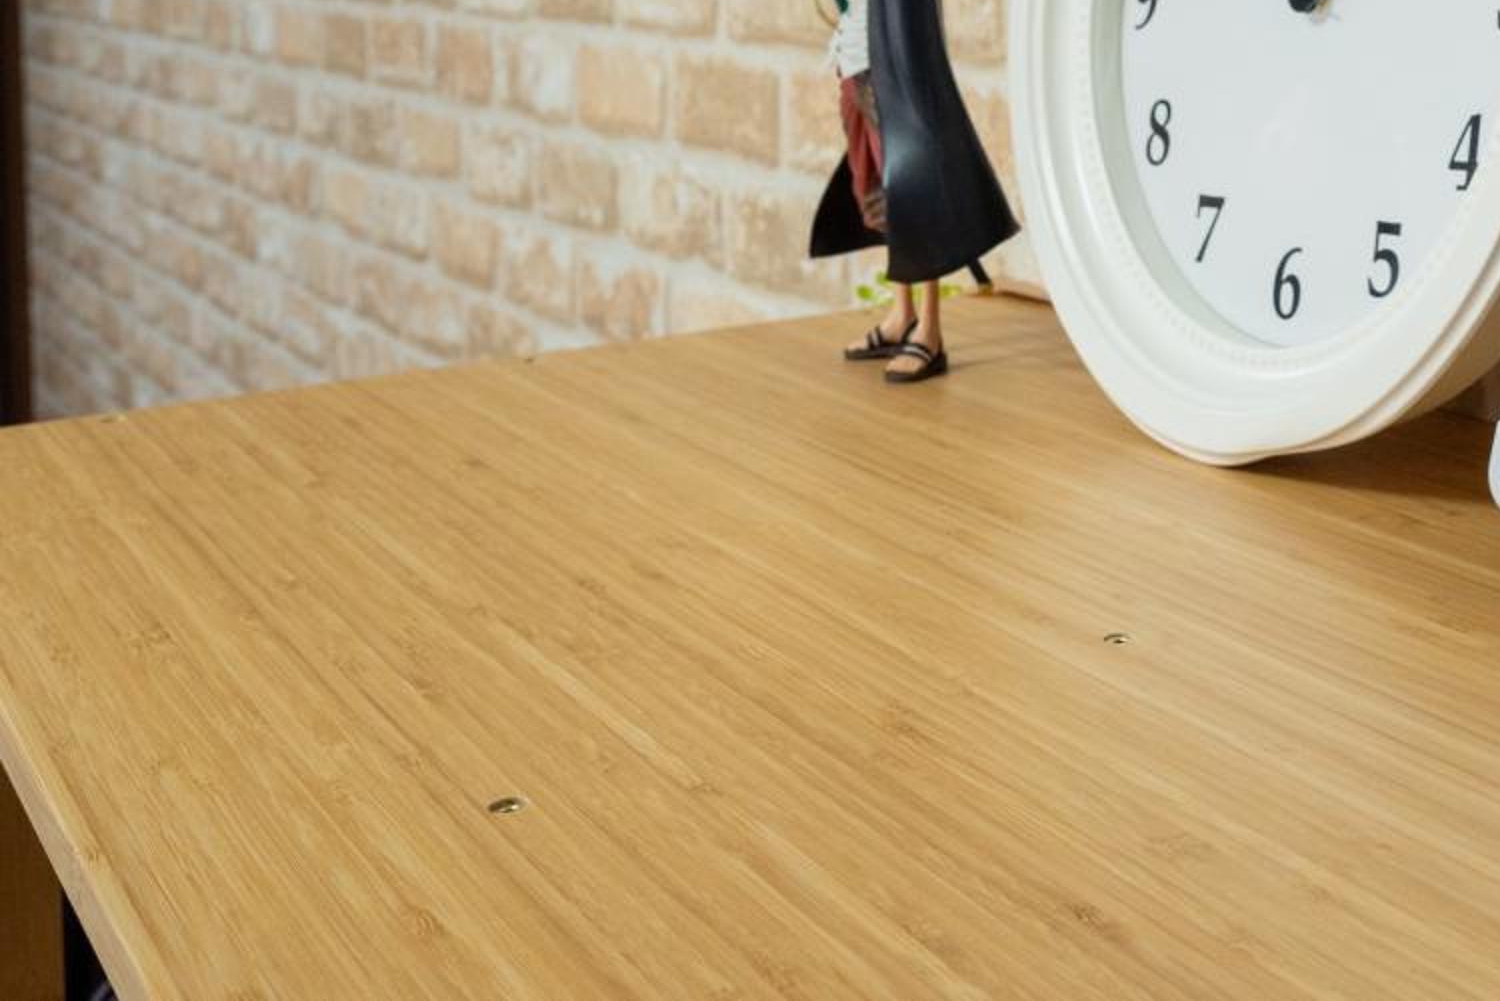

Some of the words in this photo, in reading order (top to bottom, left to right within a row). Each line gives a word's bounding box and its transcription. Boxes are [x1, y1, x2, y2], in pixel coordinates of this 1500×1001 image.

[1146, 100, 1172, 166] 8
[1448, 113, 1483, 191] 4
[1195, 194, 1225, 263] 7
[1367, 221, 1402, 298] 5
[1272, 248, 1303, 320] 6
